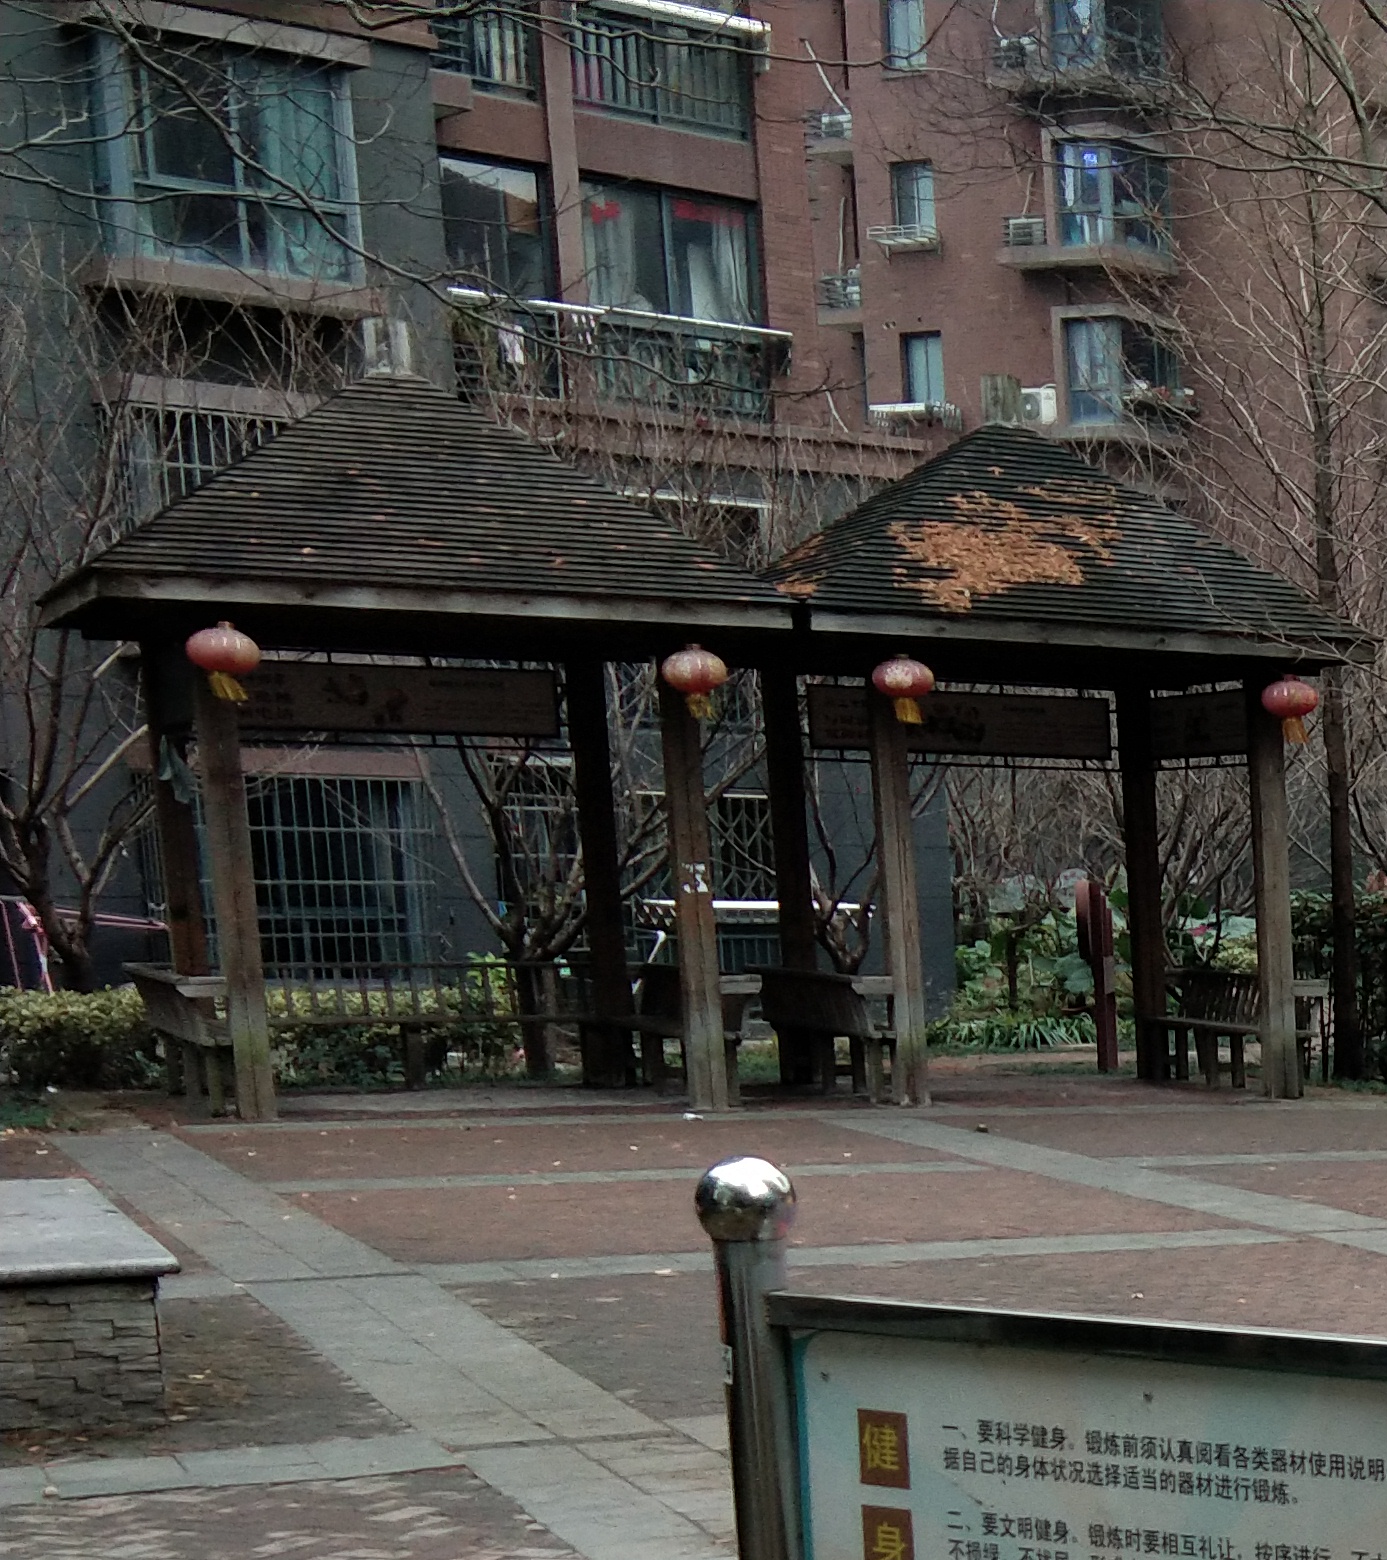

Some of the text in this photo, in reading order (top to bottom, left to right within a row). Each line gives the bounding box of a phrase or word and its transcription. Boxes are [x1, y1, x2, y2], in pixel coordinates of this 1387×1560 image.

[943, 1447, 1299, 1505] 据自己的身体状况选择适当的器材进行锻炼。
